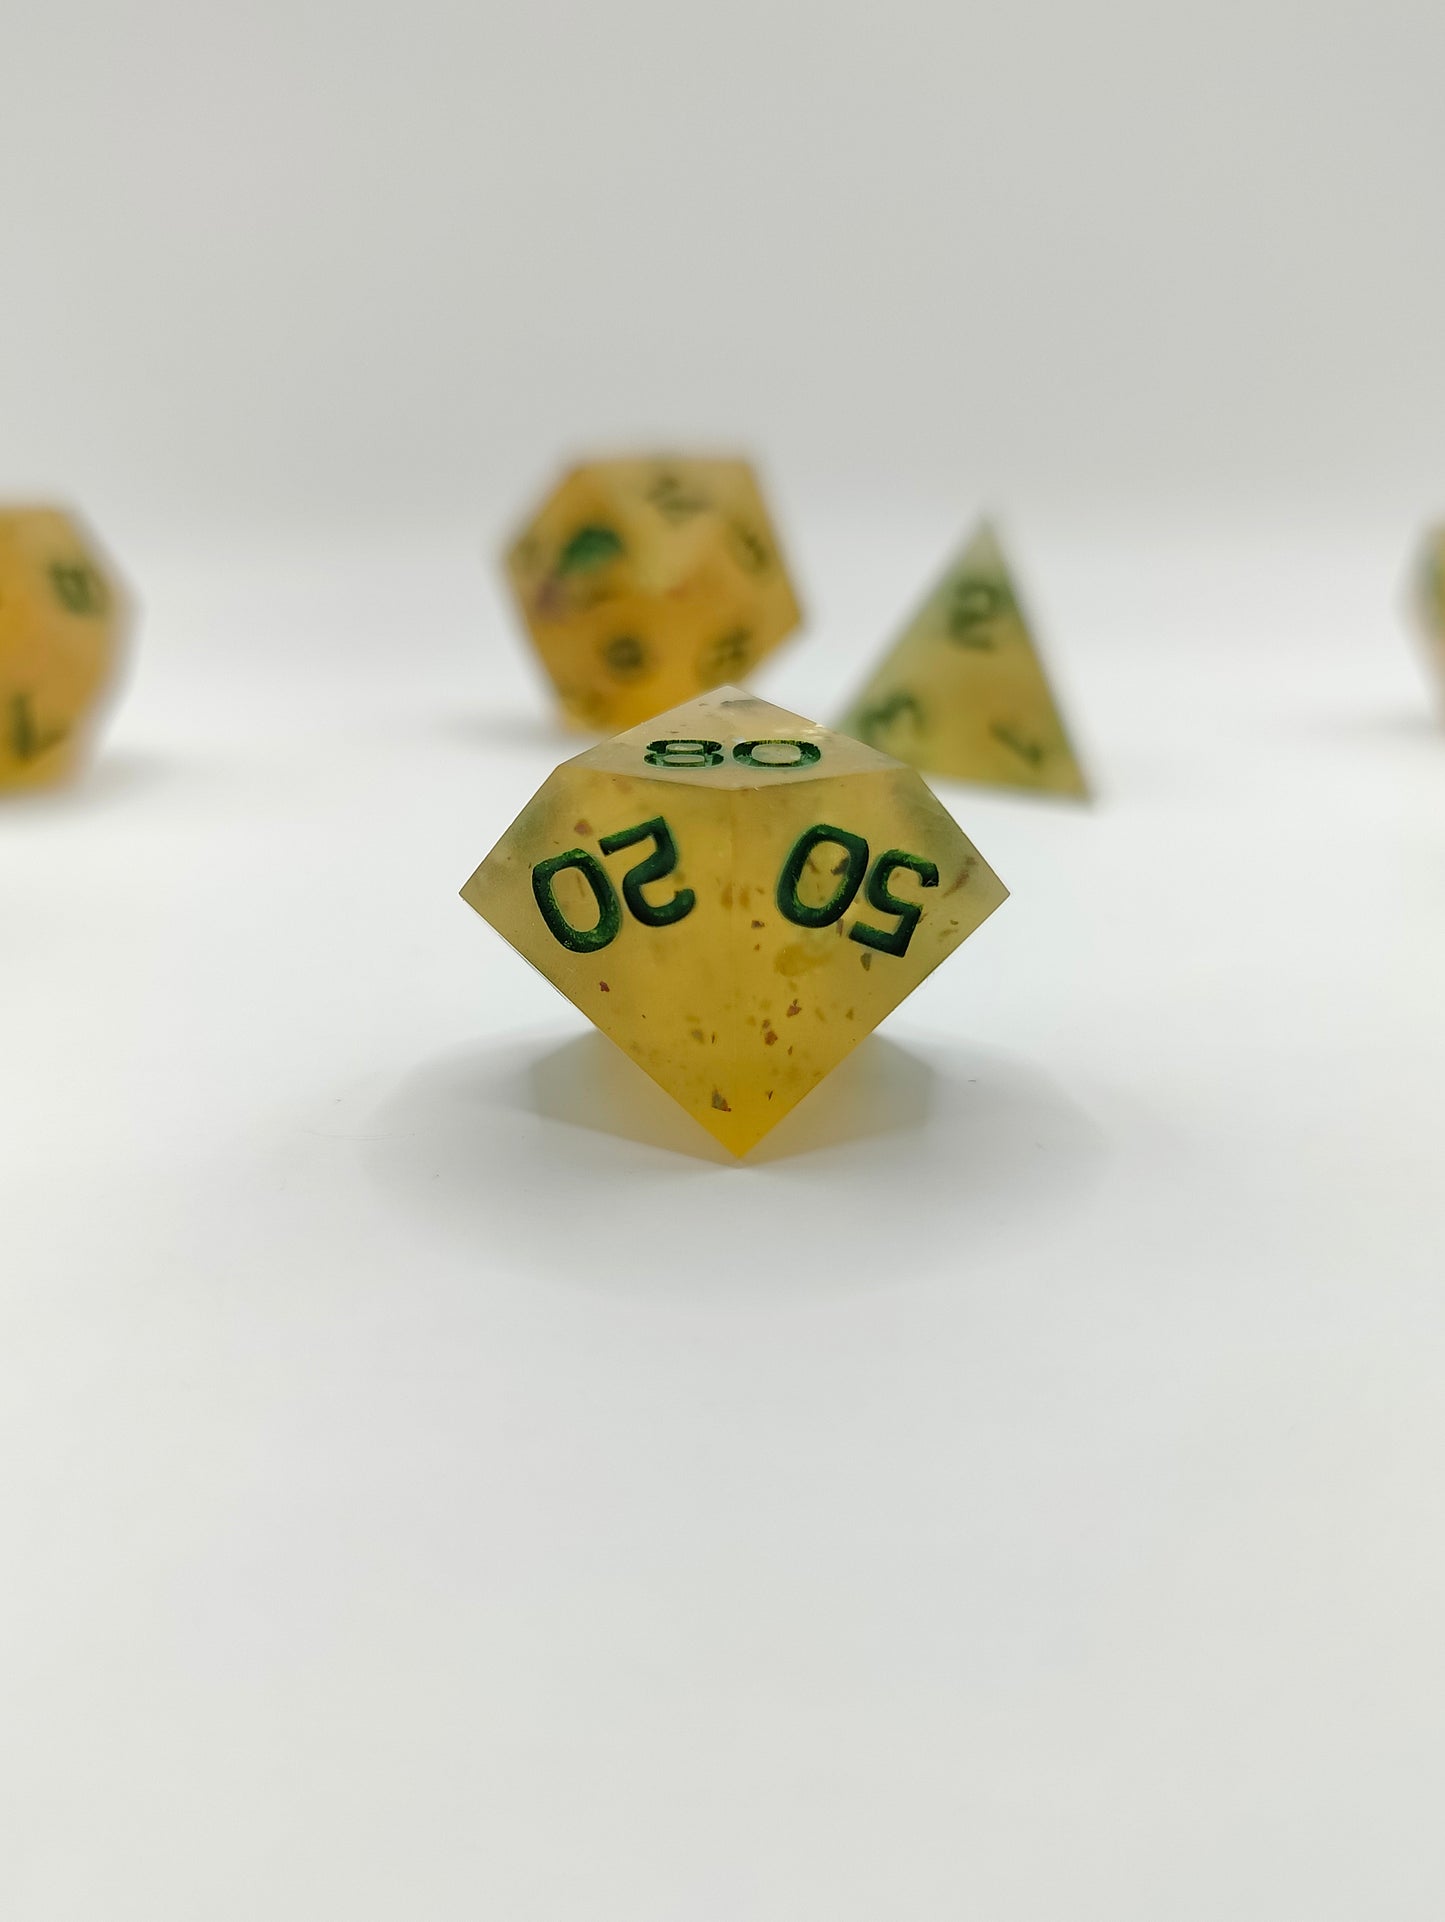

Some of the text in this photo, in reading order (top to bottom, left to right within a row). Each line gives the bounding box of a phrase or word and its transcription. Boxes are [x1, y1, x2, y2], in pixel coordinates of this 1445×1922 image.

[643, 739, 822, 768] 80
[531, 816, 697, 953] 20
[775, 823, 941, 958] 50
